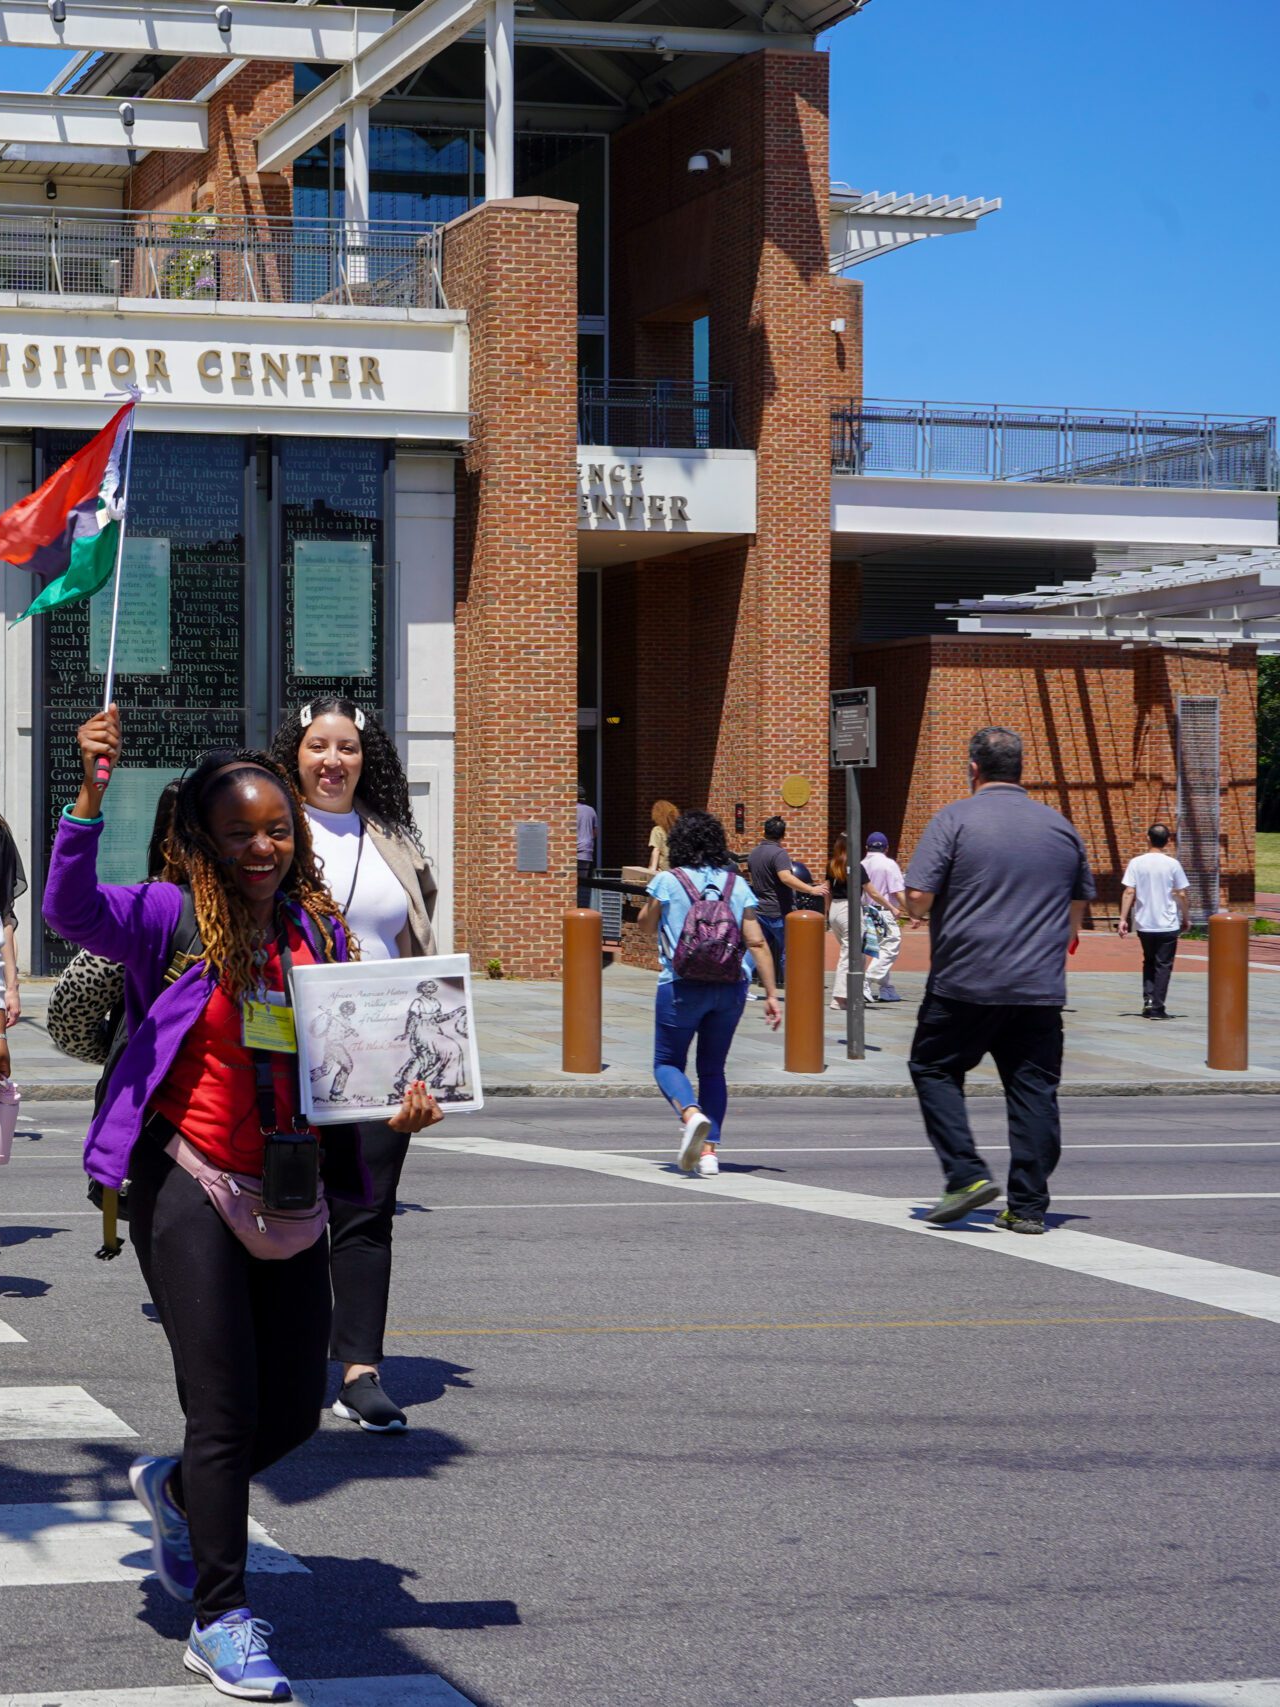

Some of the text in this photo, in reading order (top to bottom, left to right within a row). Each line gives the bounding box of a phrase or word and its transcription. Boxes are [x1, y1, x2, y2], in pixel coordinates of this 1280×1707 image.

[197, 349, 382, 385] CENTER
[578, 494, 691, 521] ENTER
[132, 514, 238, 531] deriving their just
[286, 518, 376, 530] unalienable
[127, 527, 238, 539] the Consent of the
[185, 553, 239, 563] becomes
[195, 577, 238, 588] to alter
[175, 588, 239, 600] to institute
[182, 600, 239, 614] laying its
[176, 613, 239, 626] Principles,
[51, 624, 238, 636] and Powers in
[51, 634, 238, 648] such them shall
[51, 647, 238, 661] seem effect their
[51, 659, 88, 672] Safety
[59, 672, 239, 684] We these Truths to be
[285, 674, 376, 686] Consent of the
[50, 684, 239, 697] self-evidnt, that all Men are
[286, 686, 376, 699] Governed, that
[51, 697, 239, 708] created that are
[128, 709, 239, 722] their Creator with
[170, 721, 238, 736] Rights, that
[137, 735, 239, 747] are Life, Liberty,
[50, 745, 160, 756] and of
[53, 757, 189, 768] That these
